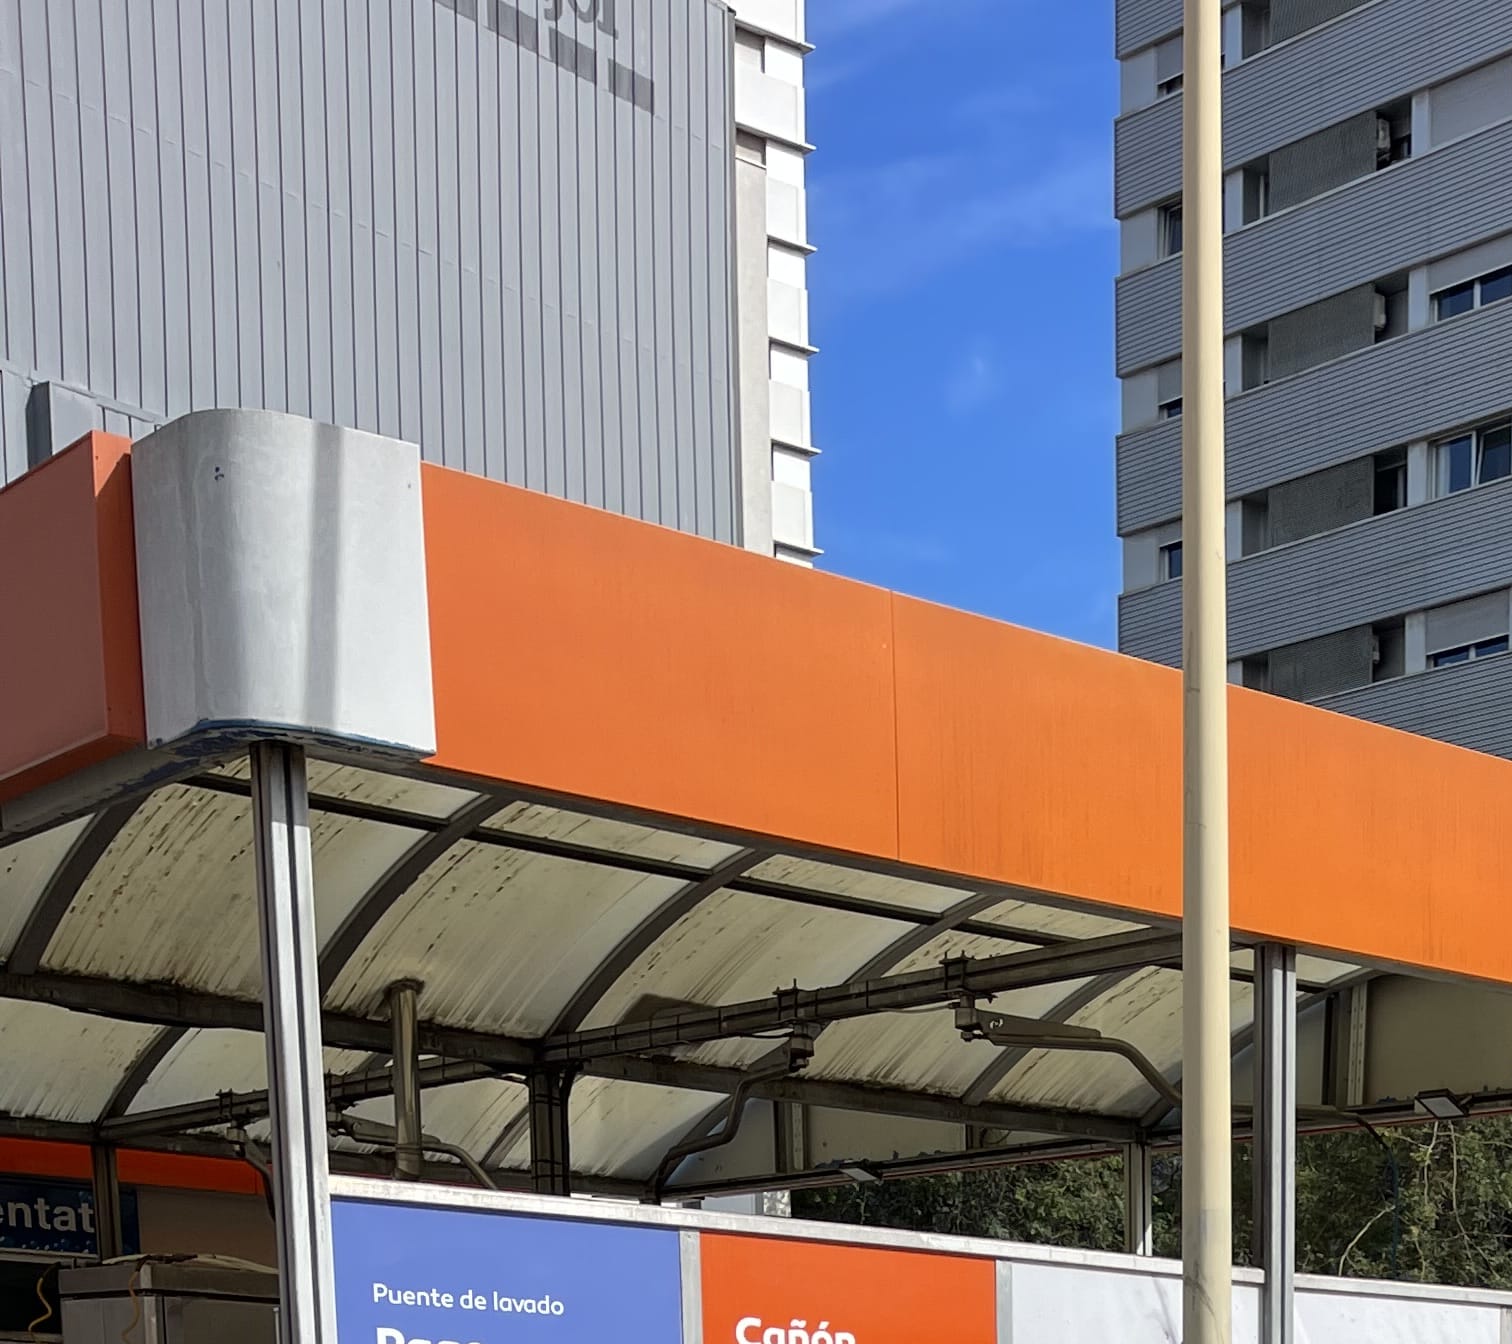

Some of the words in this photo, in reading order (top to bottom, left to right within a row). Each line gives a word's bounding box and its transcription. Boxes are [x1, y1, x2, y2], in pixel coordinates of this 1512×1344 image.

[0, 1197, 95, 1233] ntat
[373, 1283, 453, 1308] Puente
[460, 1290, 486, 1310] de
[494, 1291, 564, 1315] lavado
